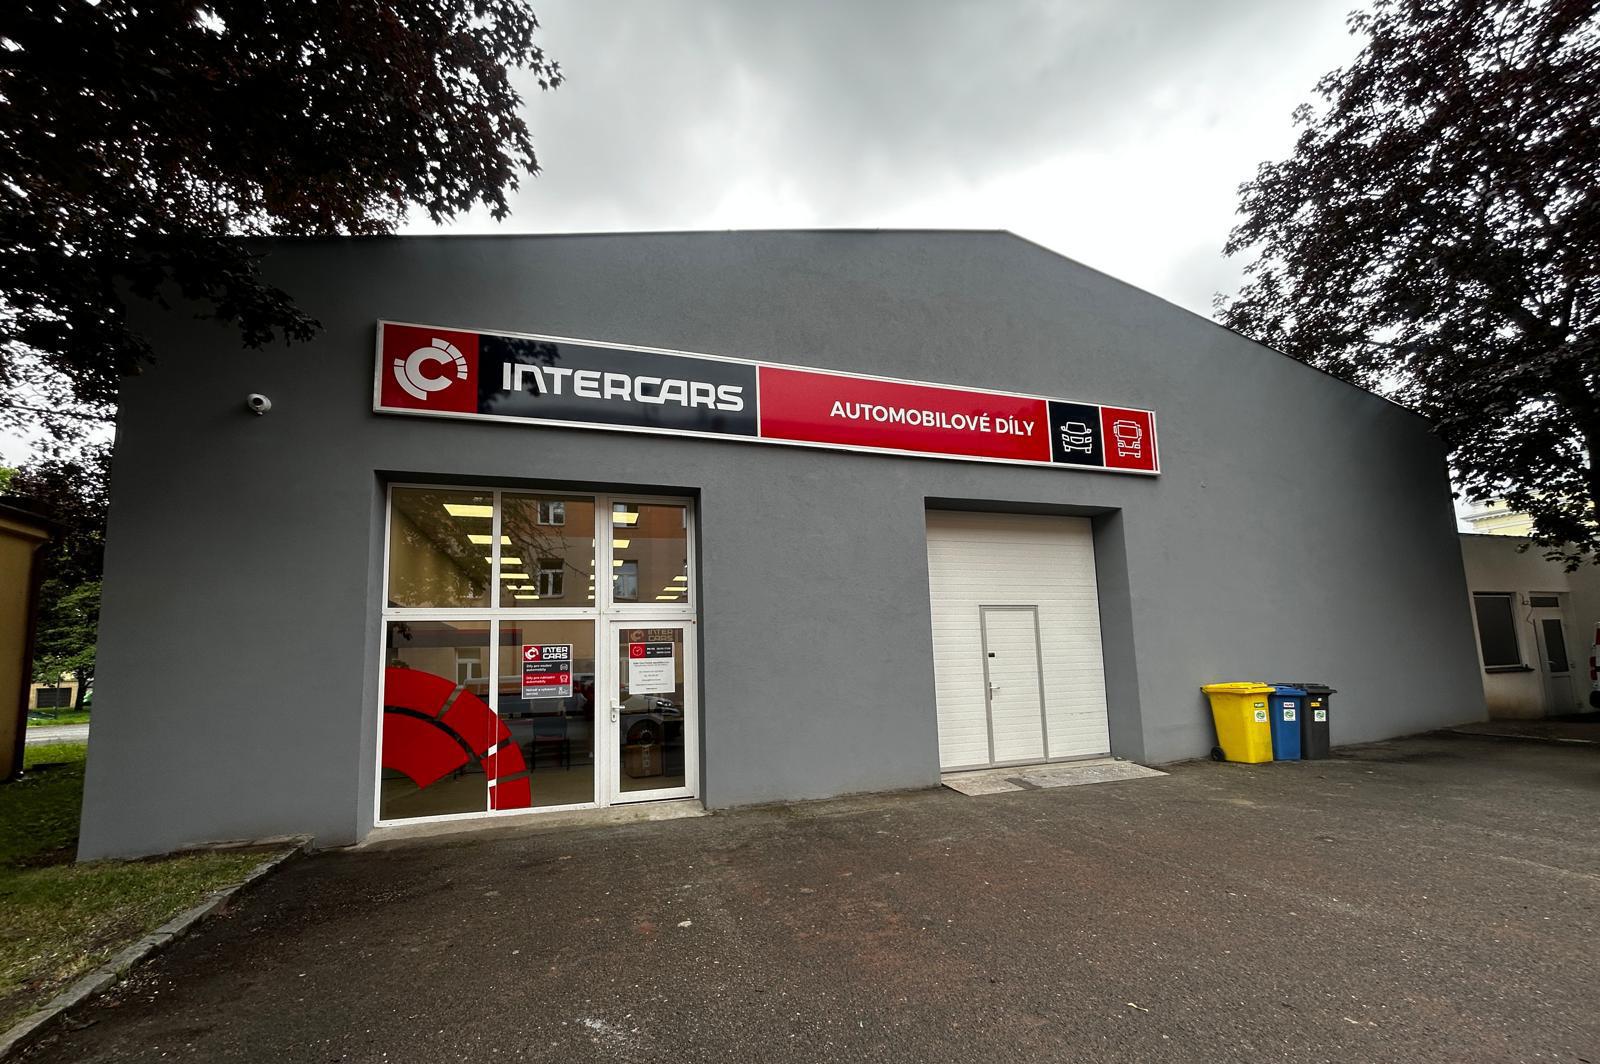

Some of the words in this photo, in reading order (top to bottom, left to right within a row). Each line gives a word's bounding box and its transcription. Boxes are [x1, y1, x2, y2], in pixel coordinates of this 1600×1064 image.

[502, 362, 744, 412] INTERCARS
[830, 400, 991, 433] AUTOMOBILOVÉ
[995, 415, 1036, 437] DÍLY
